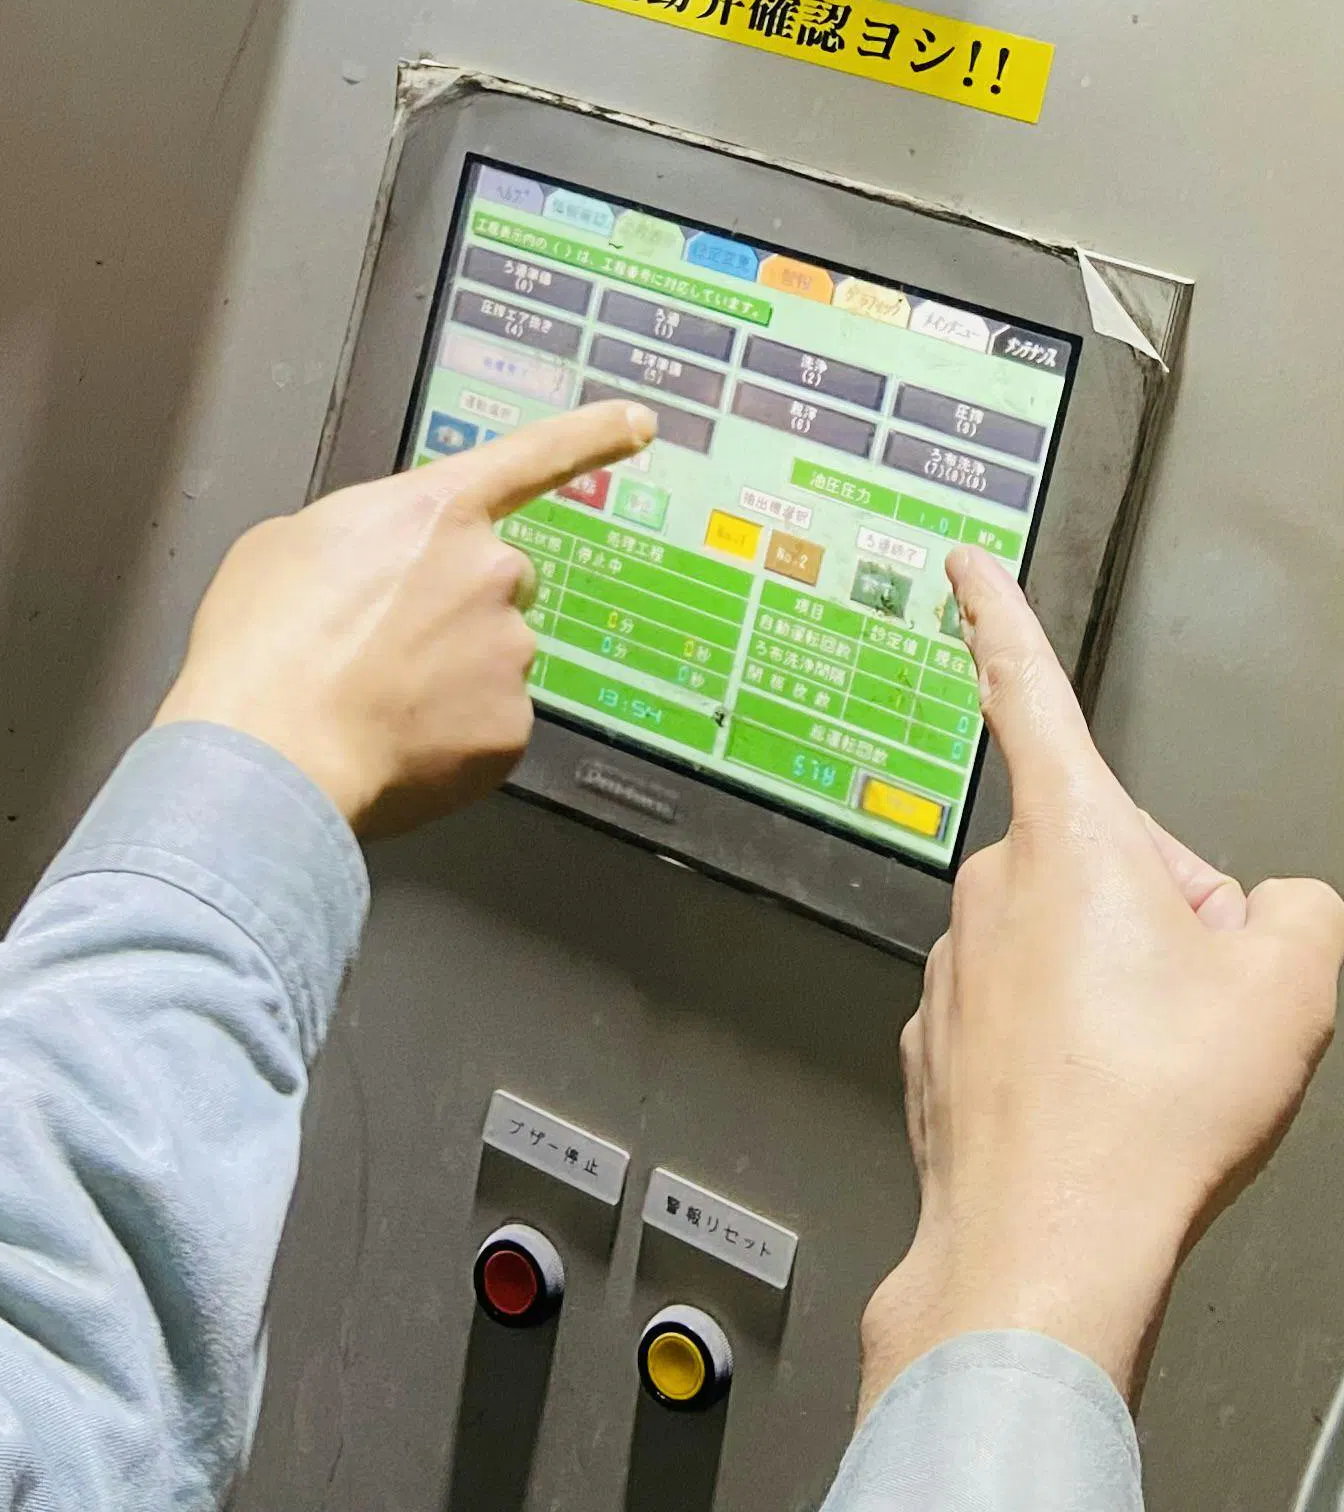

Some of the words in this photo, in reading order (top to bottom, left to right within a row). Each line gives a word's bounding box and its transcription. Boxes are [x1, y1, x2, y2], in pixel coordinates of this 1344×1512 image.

[504, 322, 525, 338] (4)
[801, 370, 822, 387] (2)
[811, 470, 872, 505] 油圧圧力
[666, 1194, 773, 1259] 警報リセット
